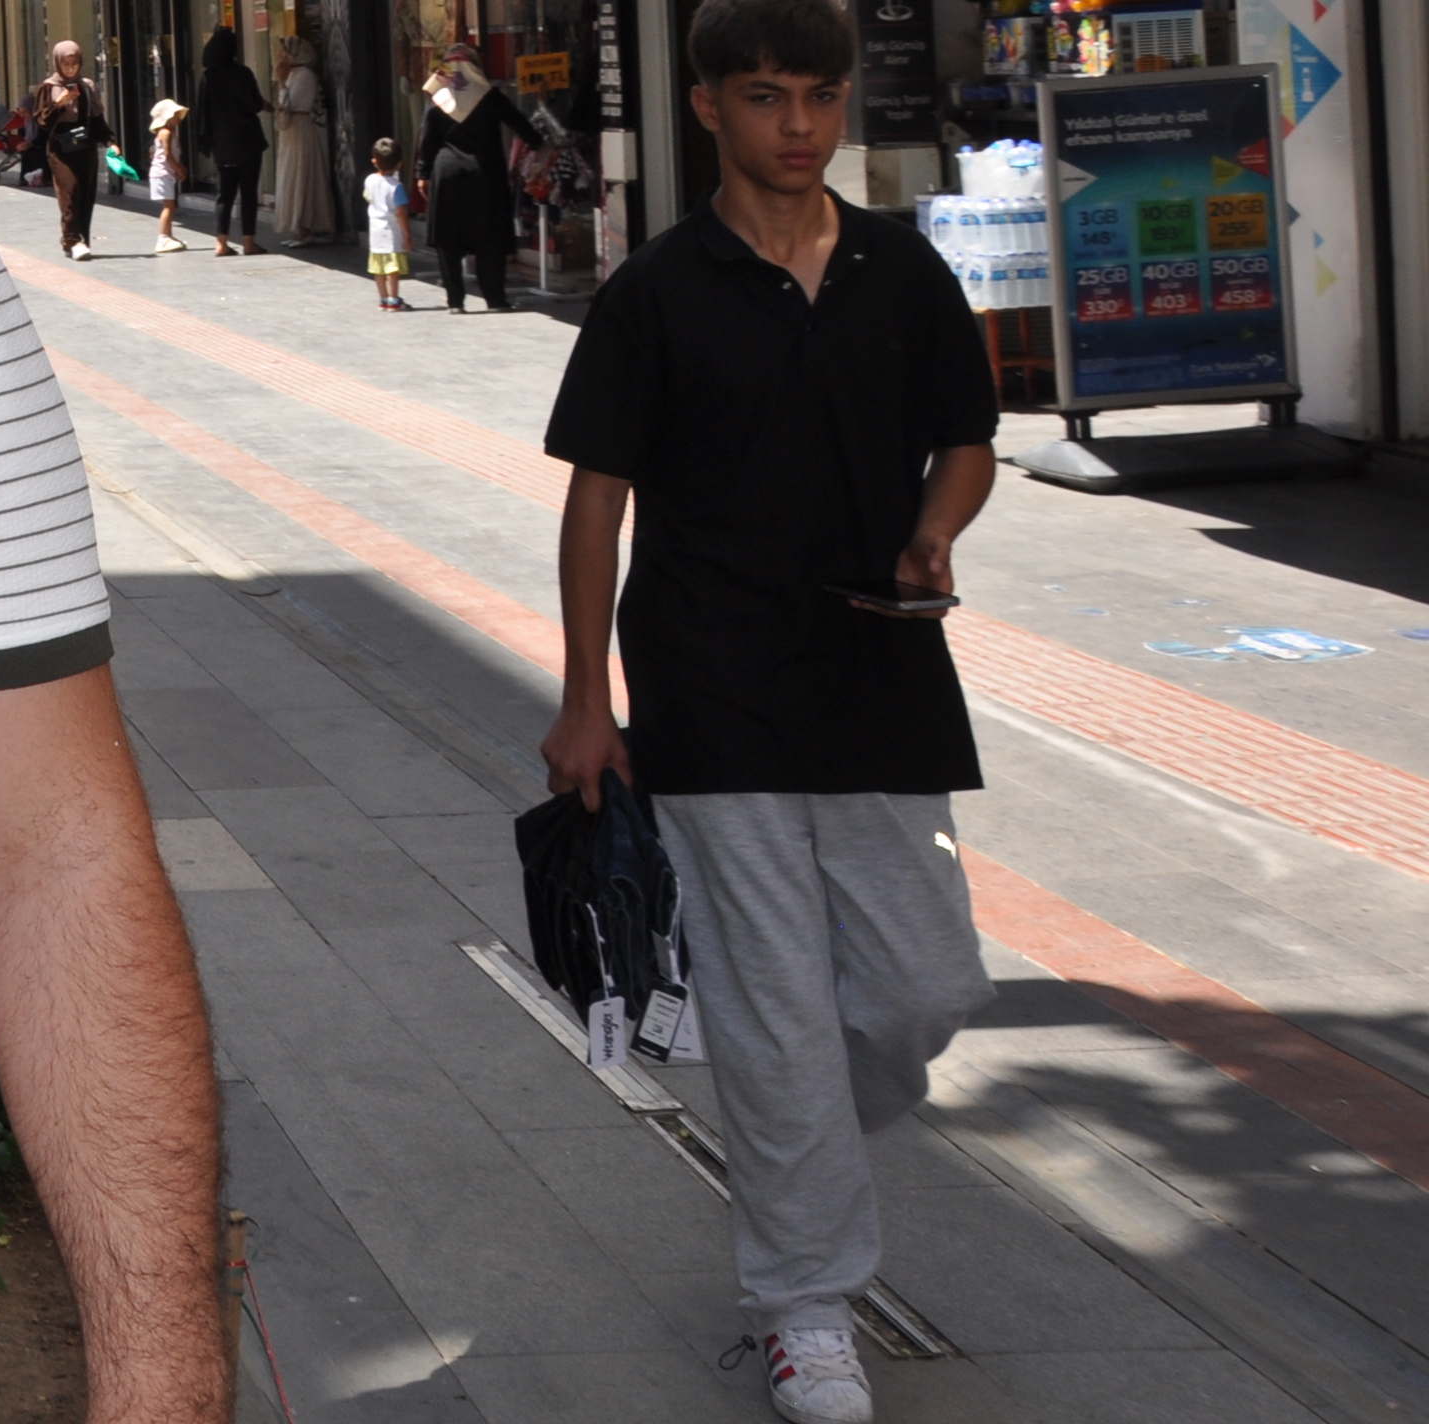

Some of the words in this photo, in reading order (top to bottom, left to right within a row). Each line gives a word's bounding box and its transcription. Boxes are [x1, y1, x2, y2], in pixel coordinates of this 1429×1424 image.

[1064, 117, 1112, 131] Yıldızlı
[1115, 111, 1174, 127] Günler'e
[1176, 109, 1209, 123] özel
[1065, 133, 1113, 146] efsane
[1115, 129, 1192, 143] kampanya
